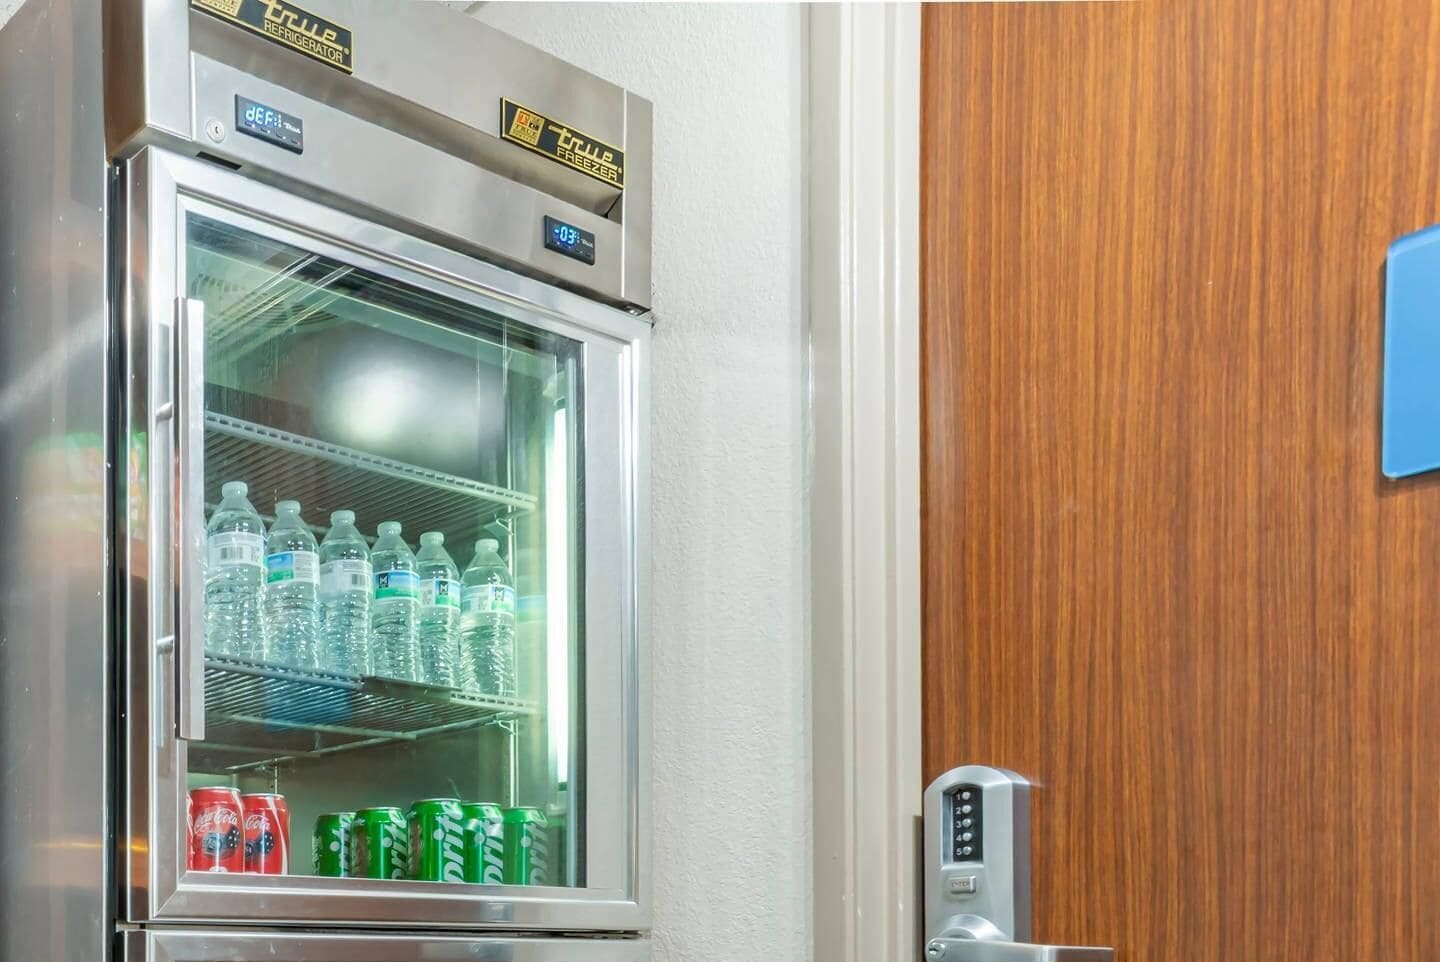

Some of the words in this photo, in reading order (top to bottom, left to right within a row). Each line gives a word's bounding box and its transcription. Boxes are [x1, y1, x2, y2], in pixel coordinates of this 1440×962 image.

[264, 19, 344, 64] REFRIGERATOR
[556, 146, 619, 181] FREEZER
[956, 792, 961, 801] 1
[955, 806, 962, 815] 2
[955, 820, 962, 829] 3
[433, 801, 464, 884] prite
[955, 834, 962, 842] 4
[474, 804, 504, 885] prite
[956, 847, 962, 856] 5
